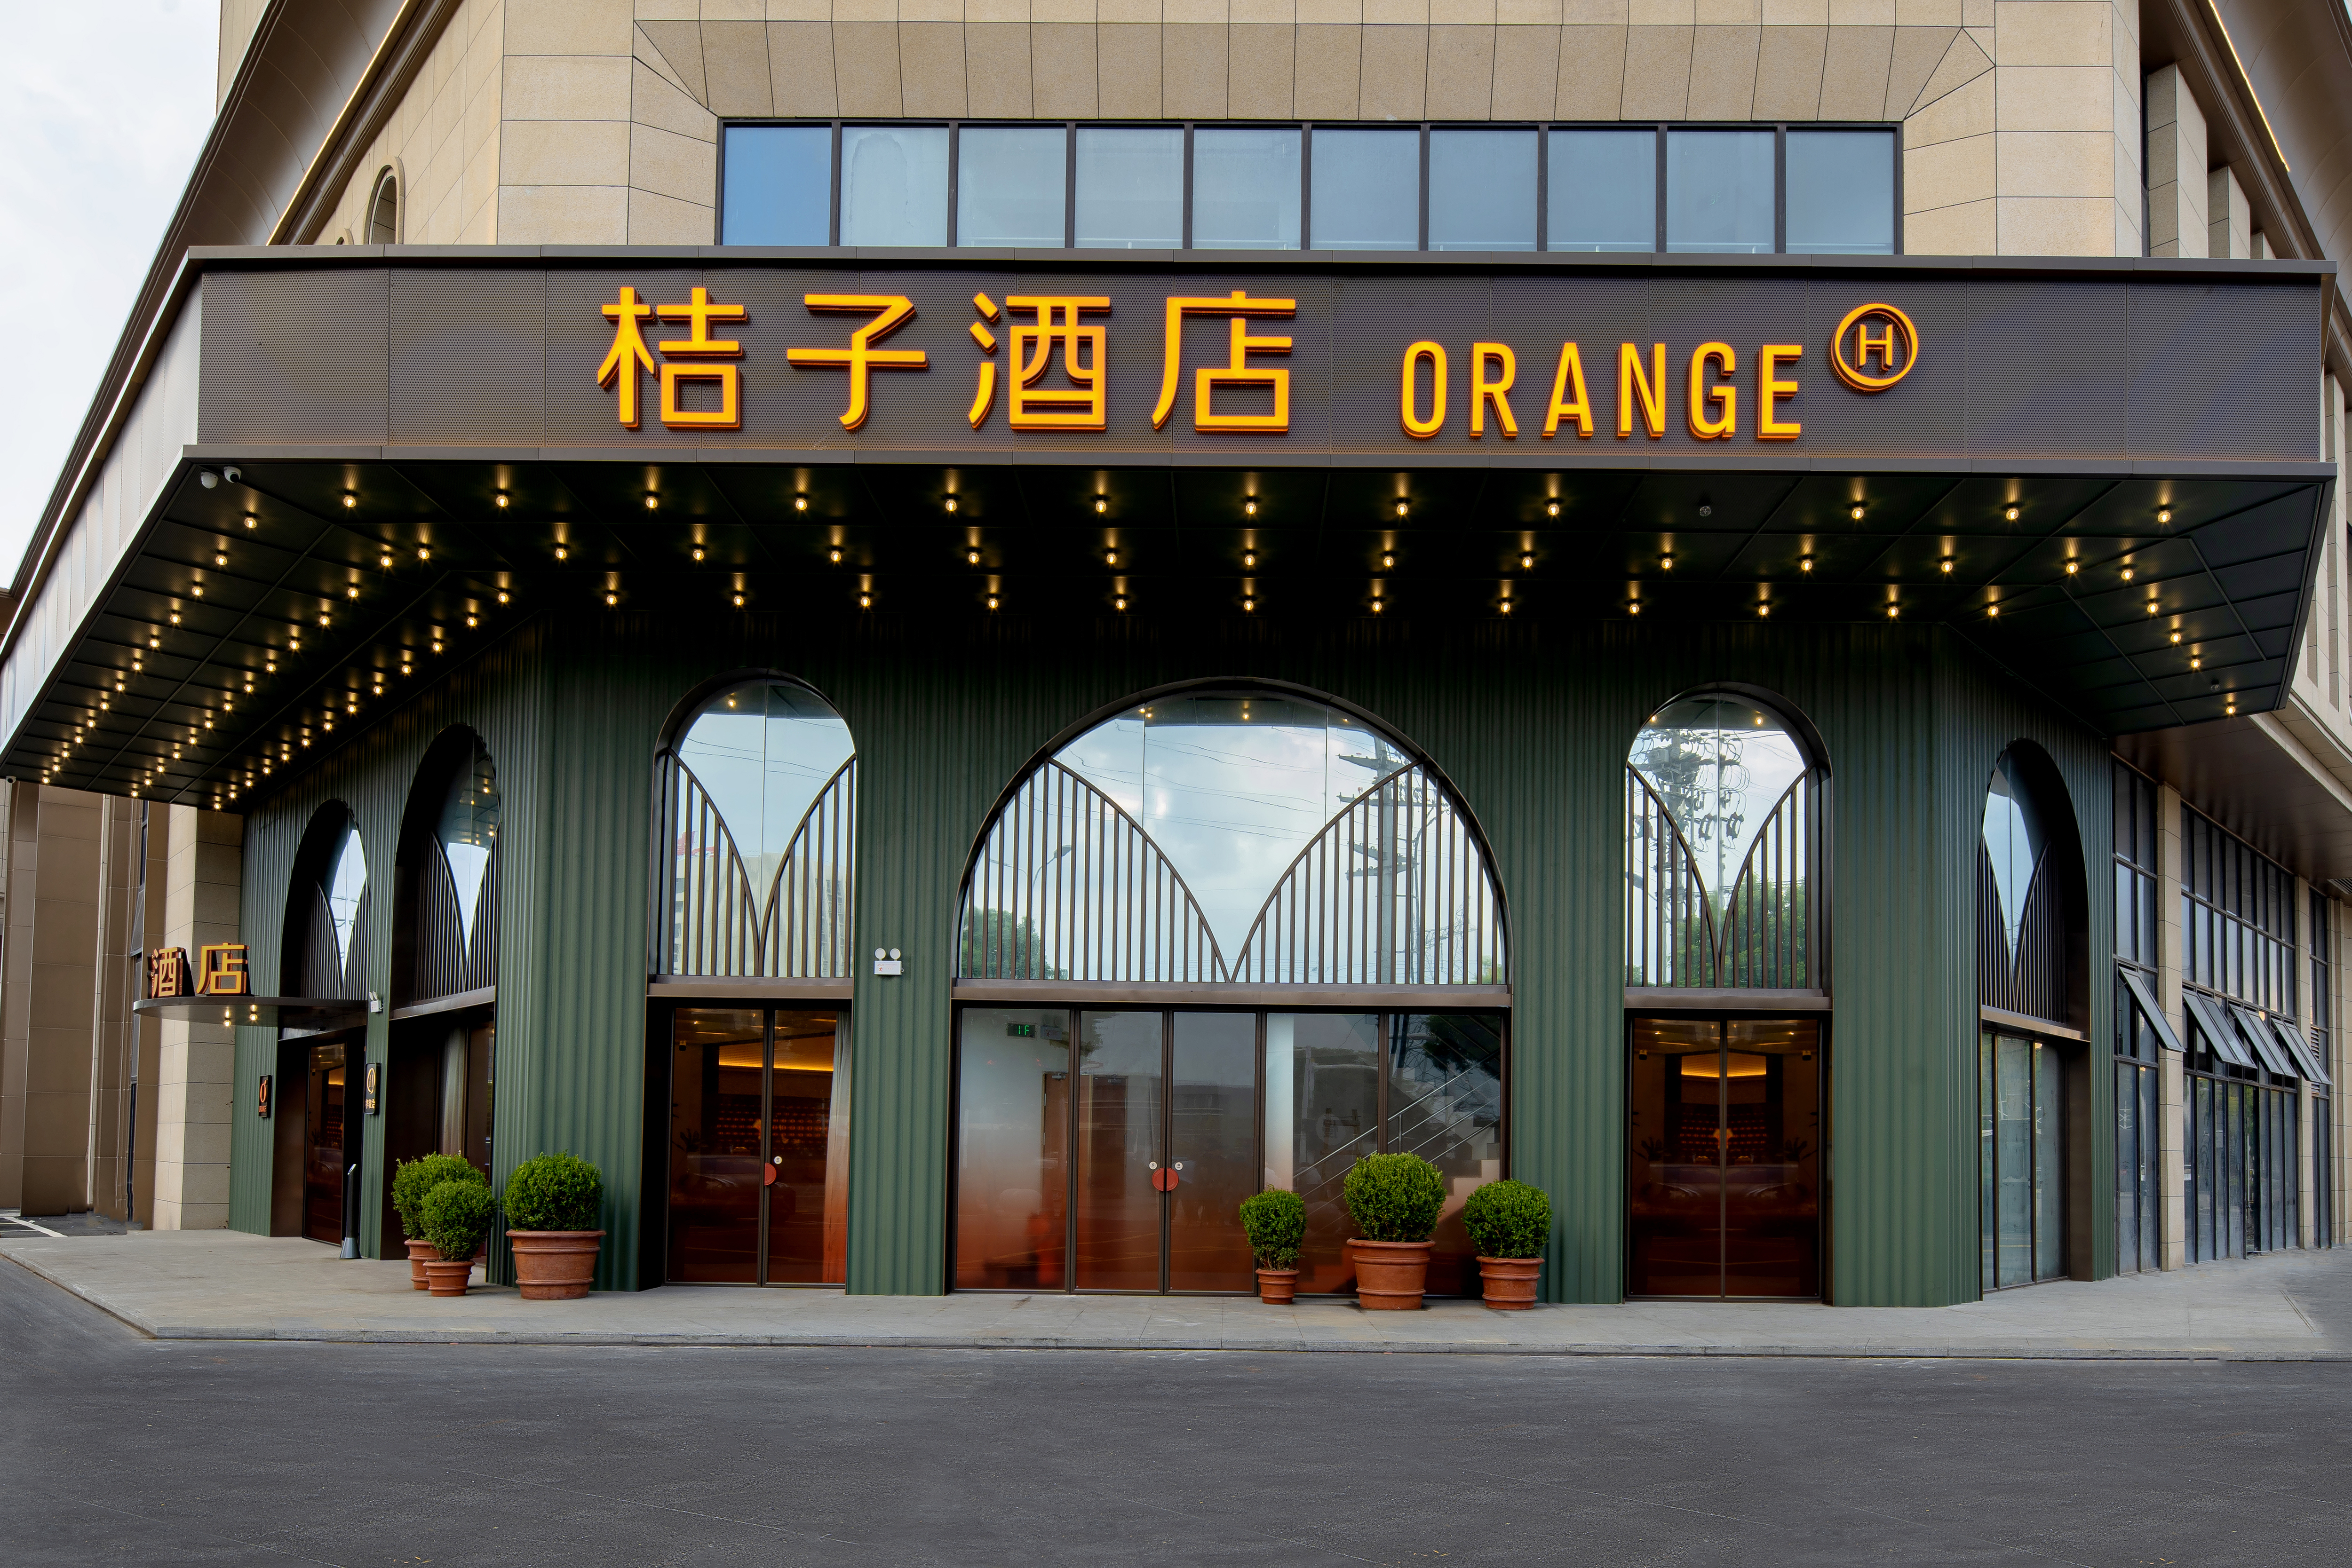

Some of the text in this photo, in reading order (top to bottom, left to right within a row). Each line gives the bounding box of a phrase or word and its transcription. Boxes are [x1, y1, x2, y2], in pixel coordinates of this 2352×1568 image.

[597, 286, 1297, 430] 桔子酒店
[1401, 341, 1802, 439] ORANGE
[151, 942, 248, 998] 酒店
